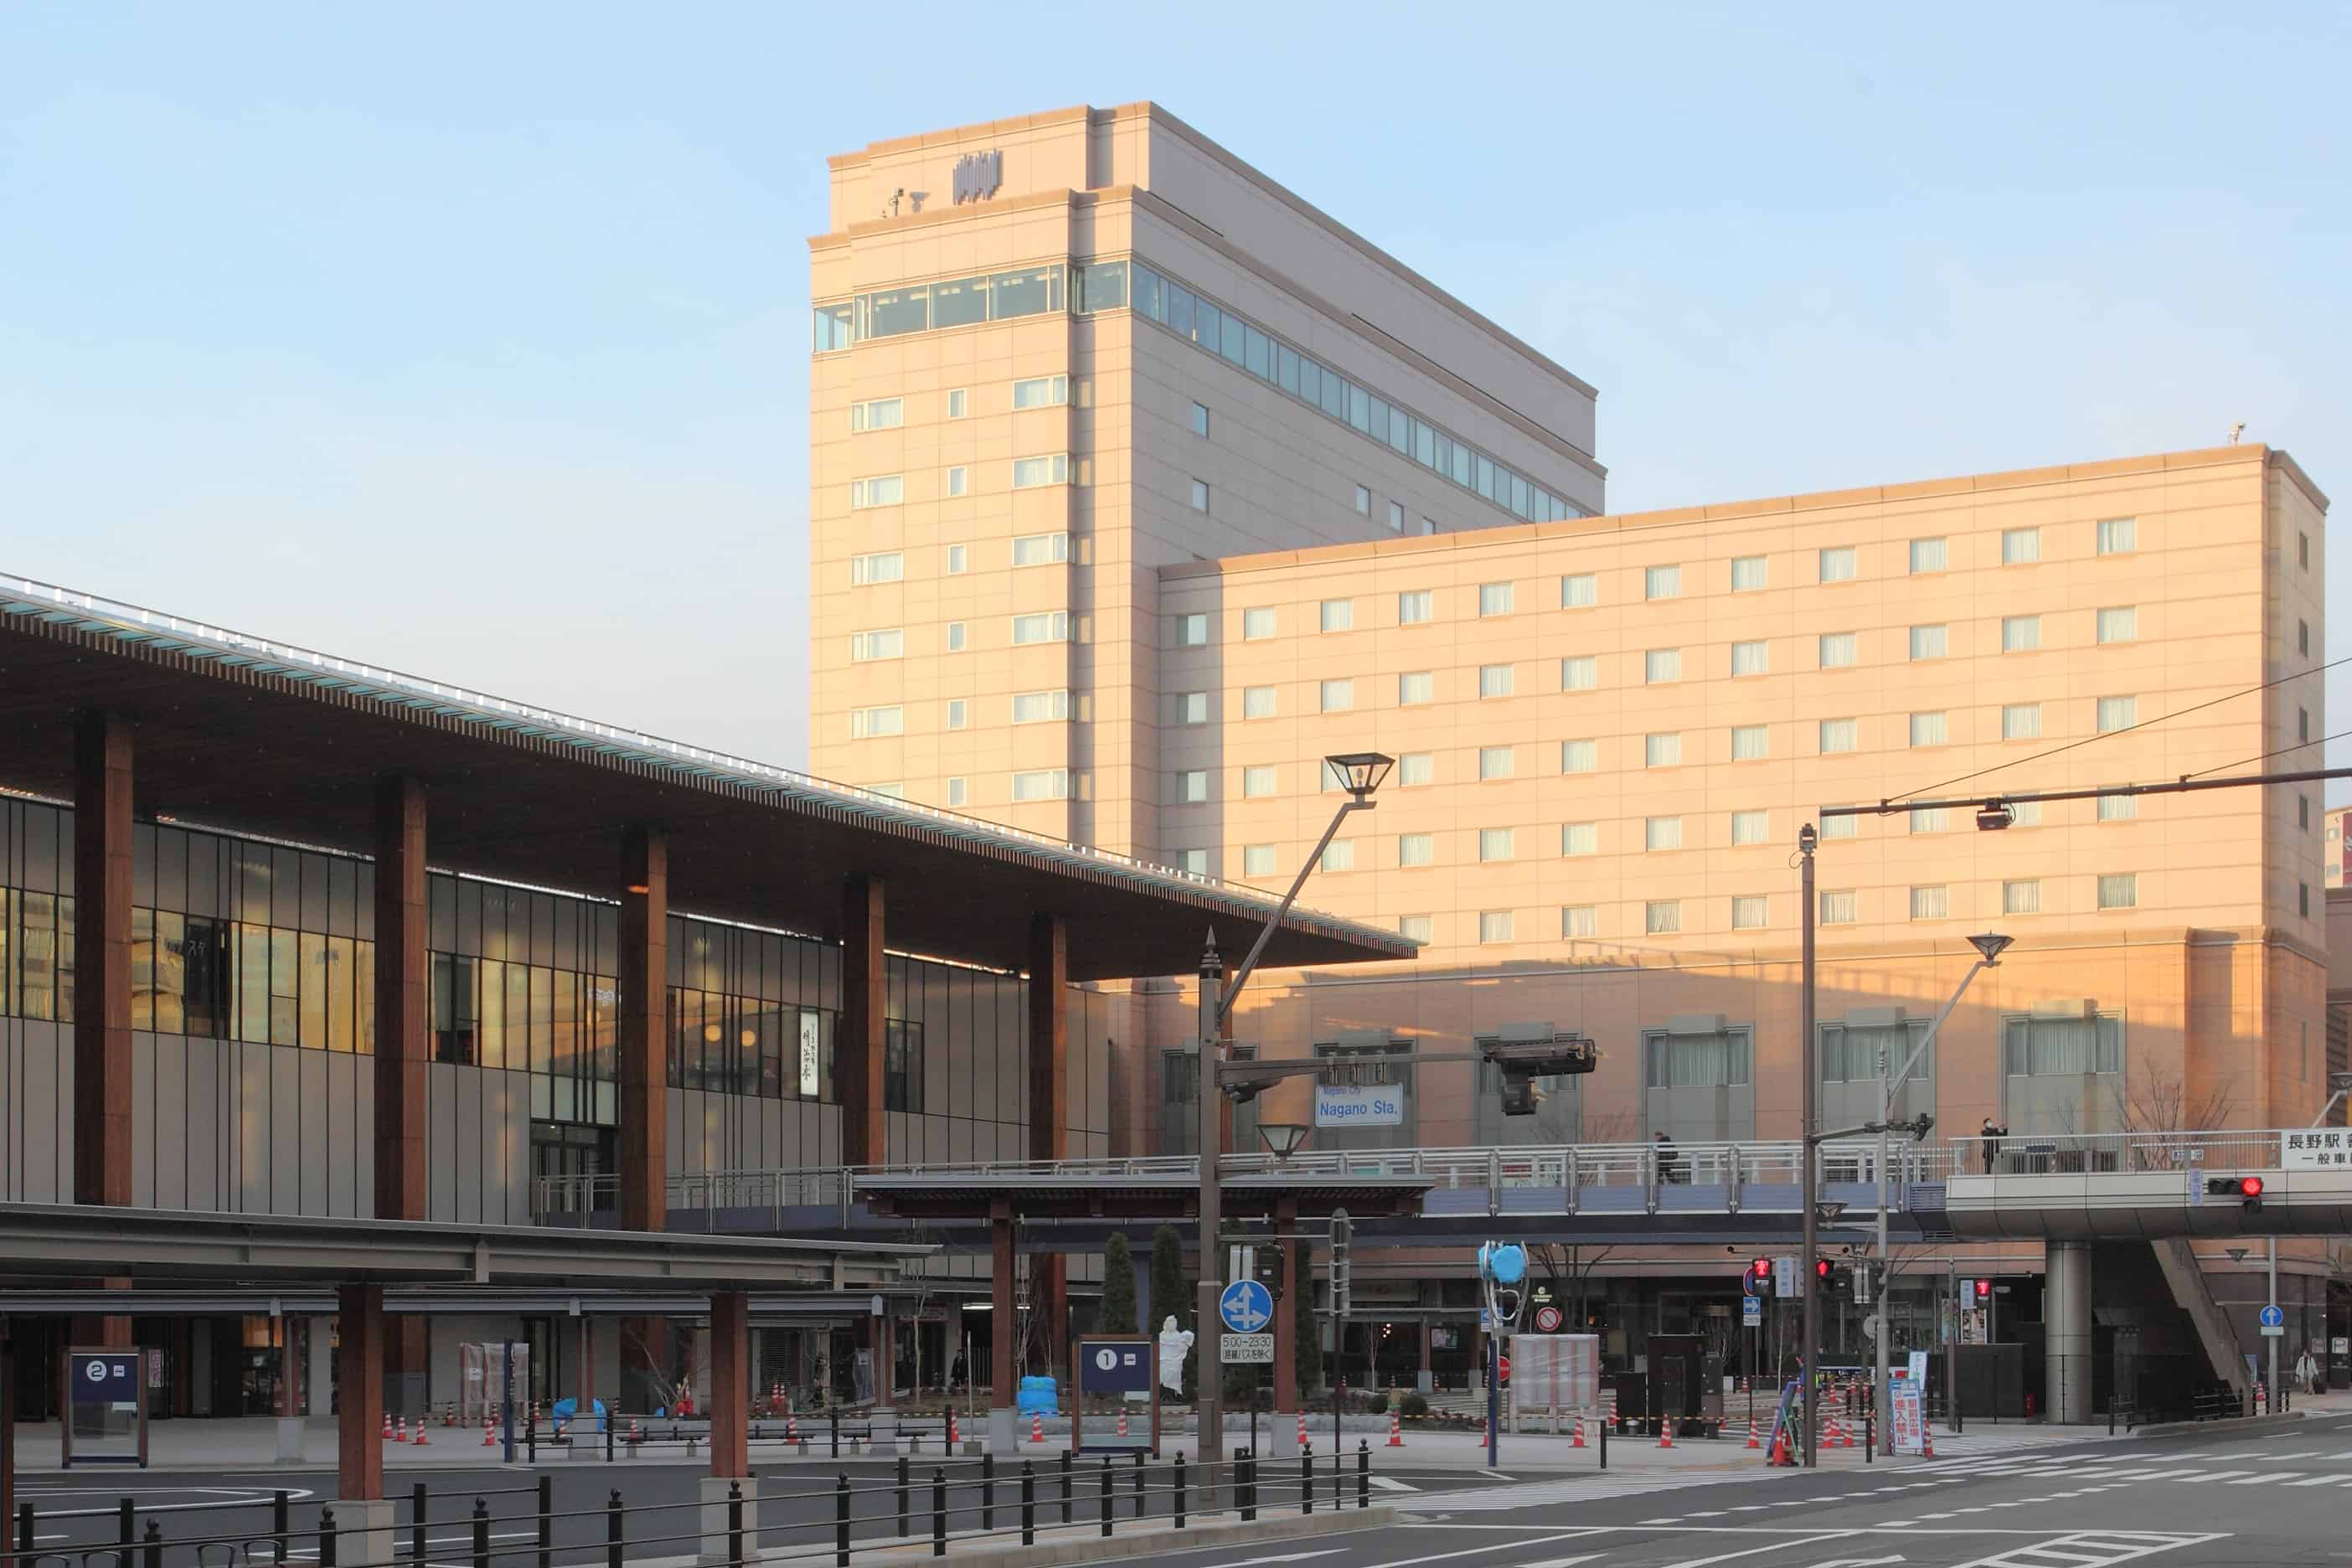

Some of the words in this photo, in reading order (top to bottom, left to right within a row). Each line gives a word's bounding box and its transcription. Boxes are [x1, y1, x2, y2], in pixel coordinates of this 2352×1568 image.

[1319, 1101, 1368, 1118] Nagano
[1373, 1100, 1398, 1115] Sta.
[2288, 1133, 2339, 1149] 長野駅
[2301, 1153, 2352, 1165] 一般車
[90, 1364, 102, 1378] 2
[1894, 1398, 1910, 1446] 進入禁止
